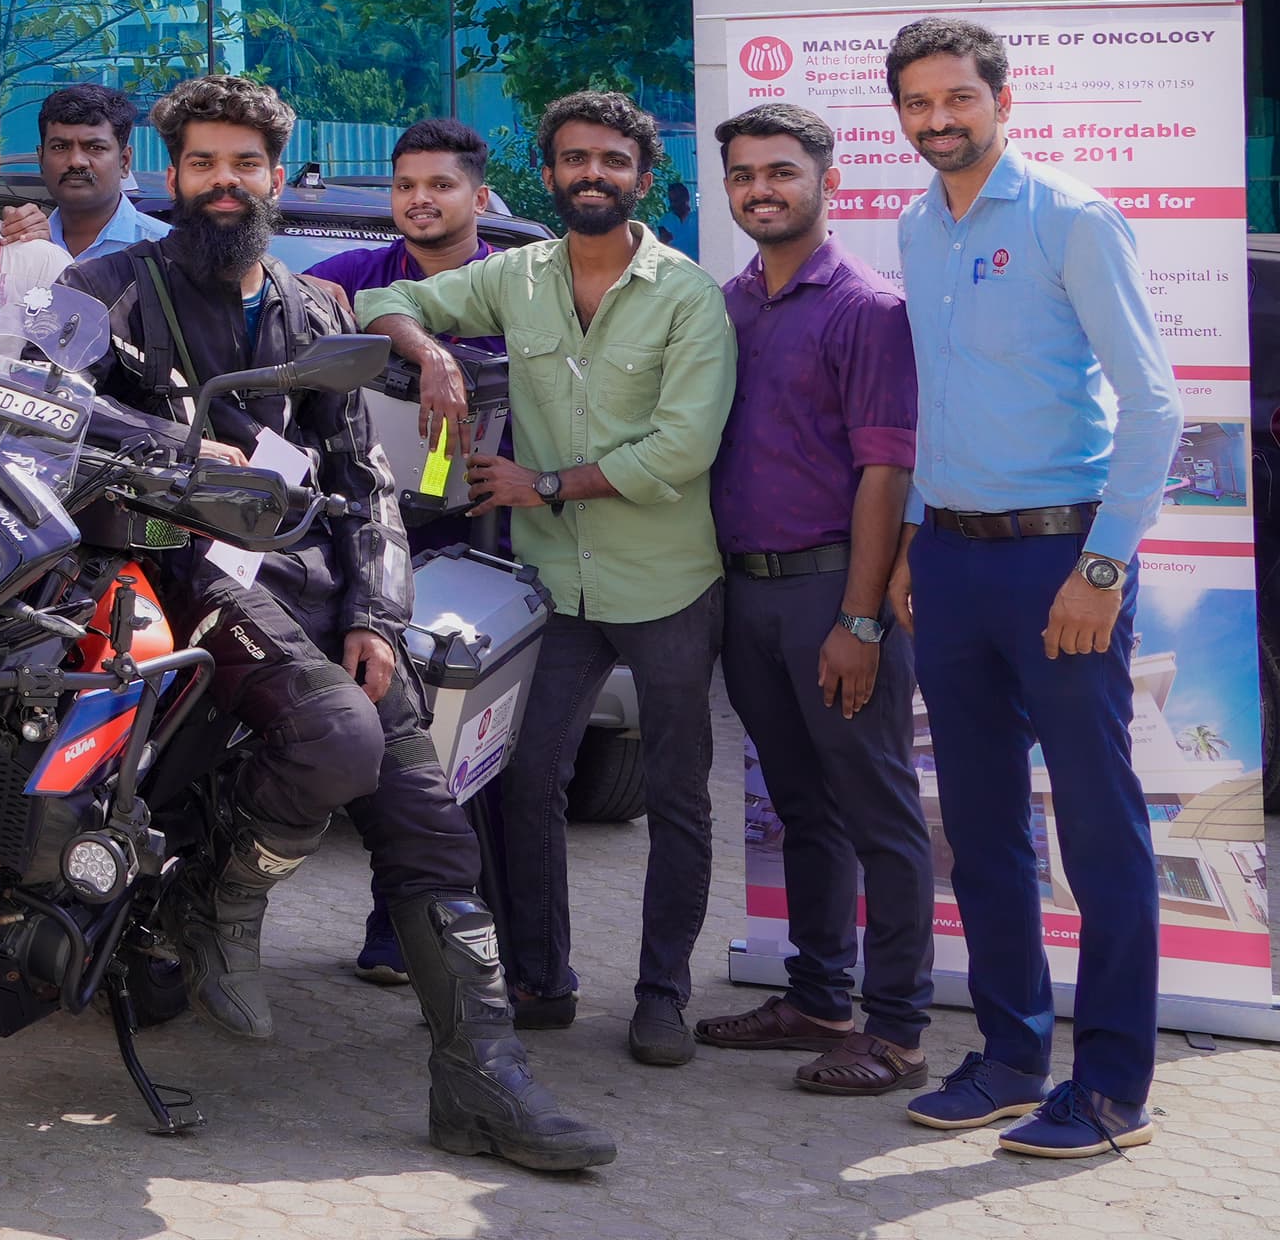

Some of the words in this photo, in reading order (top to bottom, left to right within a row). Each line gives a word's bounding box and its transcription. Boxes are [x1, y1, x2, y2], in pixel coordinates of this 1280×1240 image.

[1057, 33, 1085, 45] OF
[1092, 30, 1215, 45] ONCOLOGY
[805, 55, 819, 65] At
[822, 54, 840, 65] the
[748, 84, 785, 98] mio
[807, 86, 866, 98] Pumpwell,
[1025, 81, 1053, 91] 0824
[1056, 80, 1078, 90] 424
[1081, 80, 1115, 91] 9999,
[1118, 79, 1154, 90] 81978
[1157, 78, 1195, 89] 07159
[1008, 124, 1053, 139] and
[1062, 122, 1197, 138] affordable
[1073, 146, 1135, 162] 2011
[1158, 193, 1195, 209] for
[1149, 269, 1210, 284] hospital
[1216, 269, 1229, 282] is
[1185, 386, 1212, 395] care
[22, 400, 76, 430] 0426
[230, 624, 267, 660] Raida
[65, 737, 97, 763] KTM
